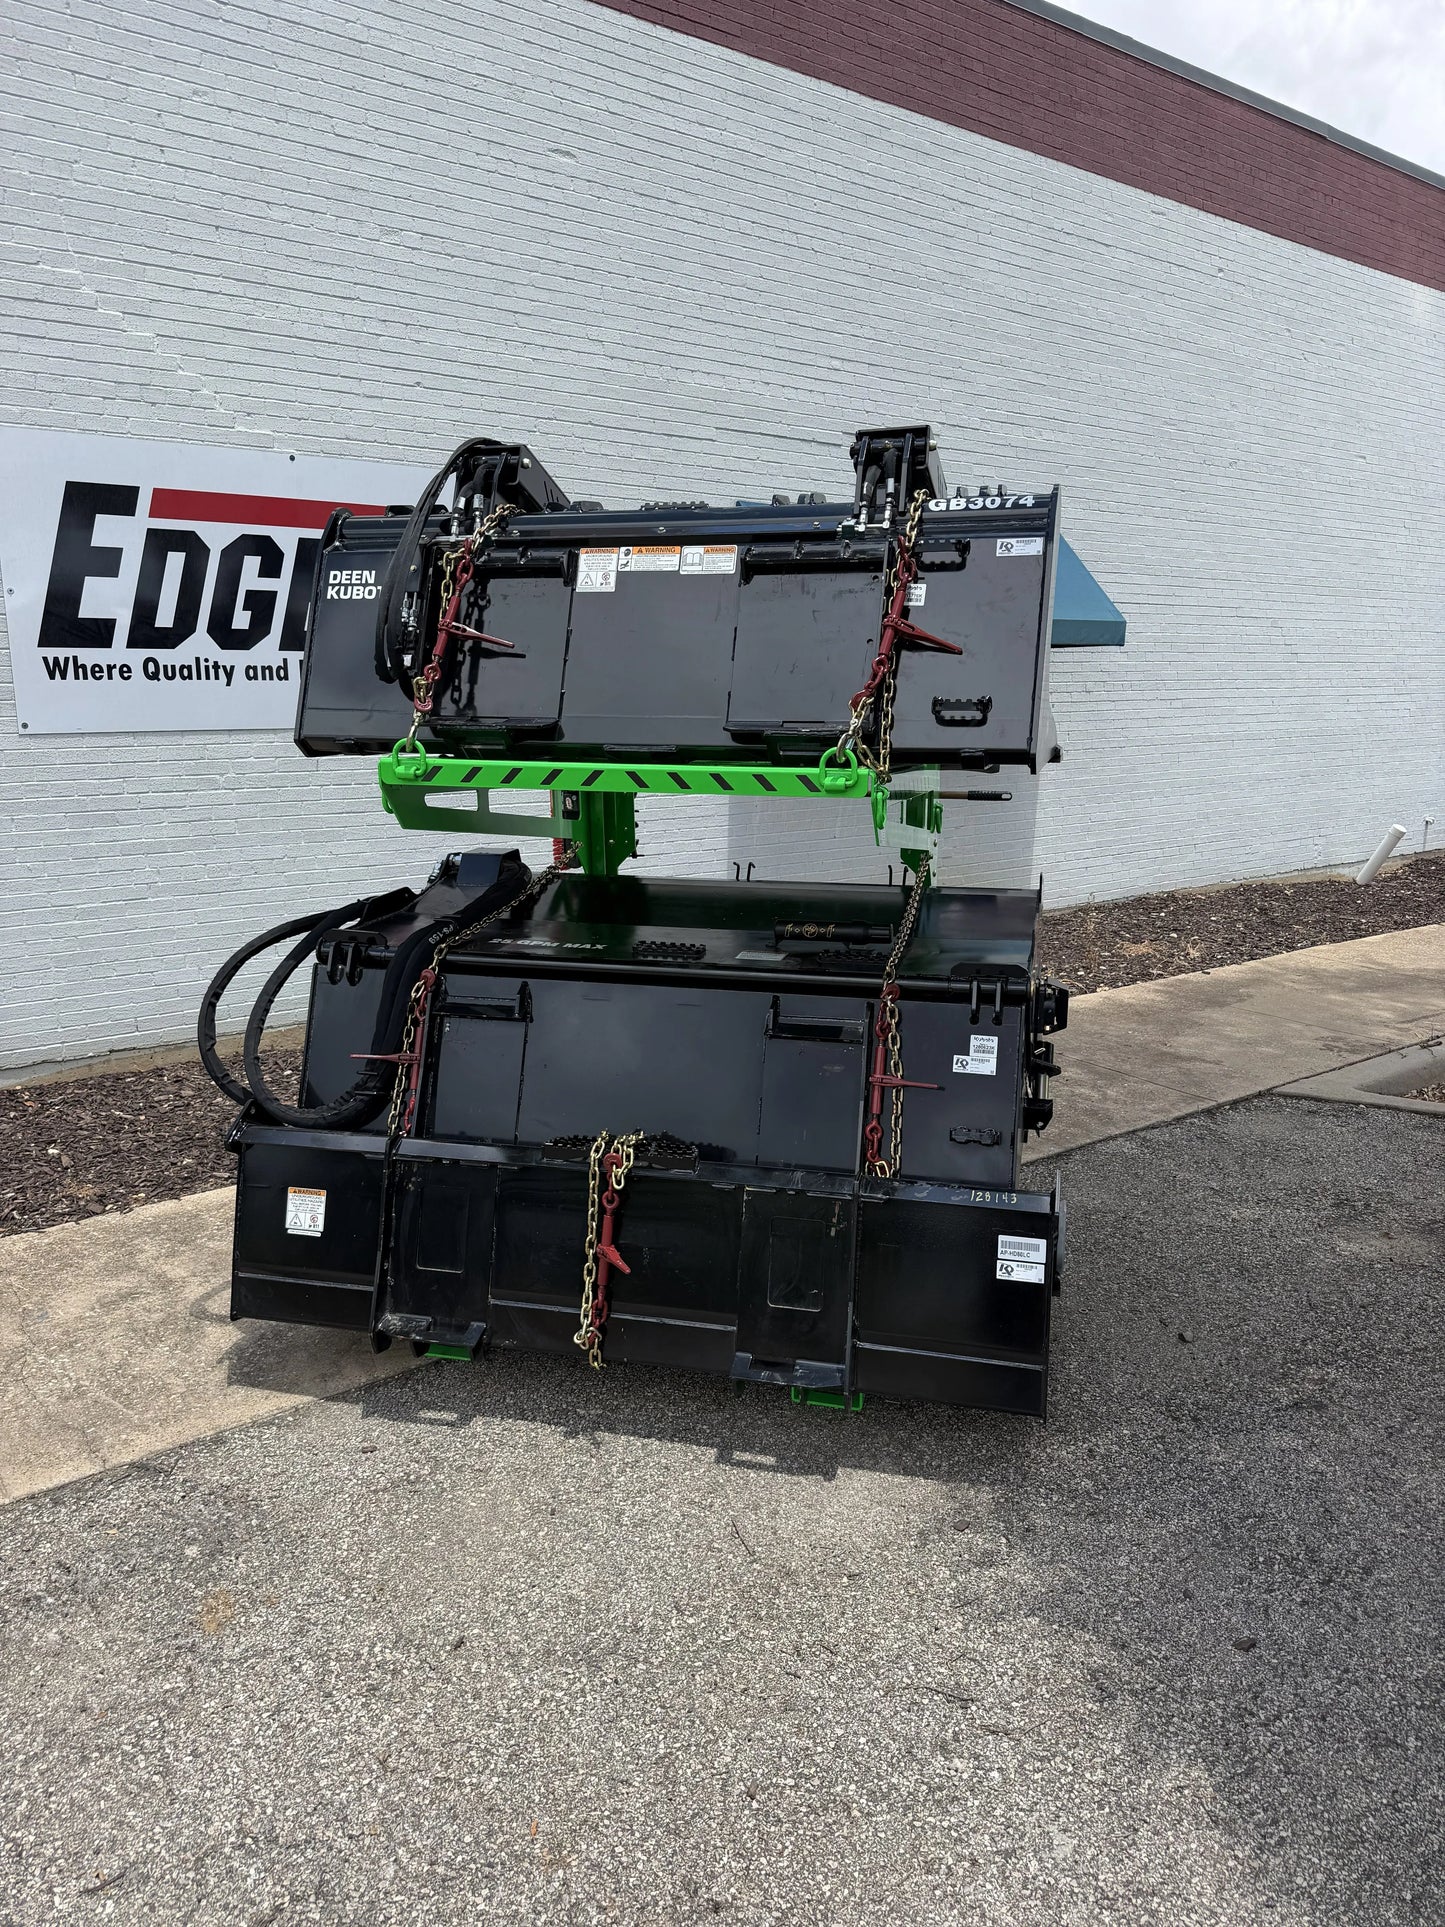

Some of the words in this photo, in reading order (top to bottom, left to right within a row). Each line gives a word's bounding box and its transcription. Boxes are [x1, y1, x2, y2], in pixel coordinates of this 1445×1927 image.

[928, 495, 1035, 511] GB3074
[329, 570, 376, 584] DEEN
[42, 655, 133, 681] Where
[142, 656, 235, 687] Quality
[244, 658, 289, 681] and
[516, 939, 560, 948] GPM
[562, 942, 608, 950] MAX
[970, 1190, 1017, 1204] 128143
